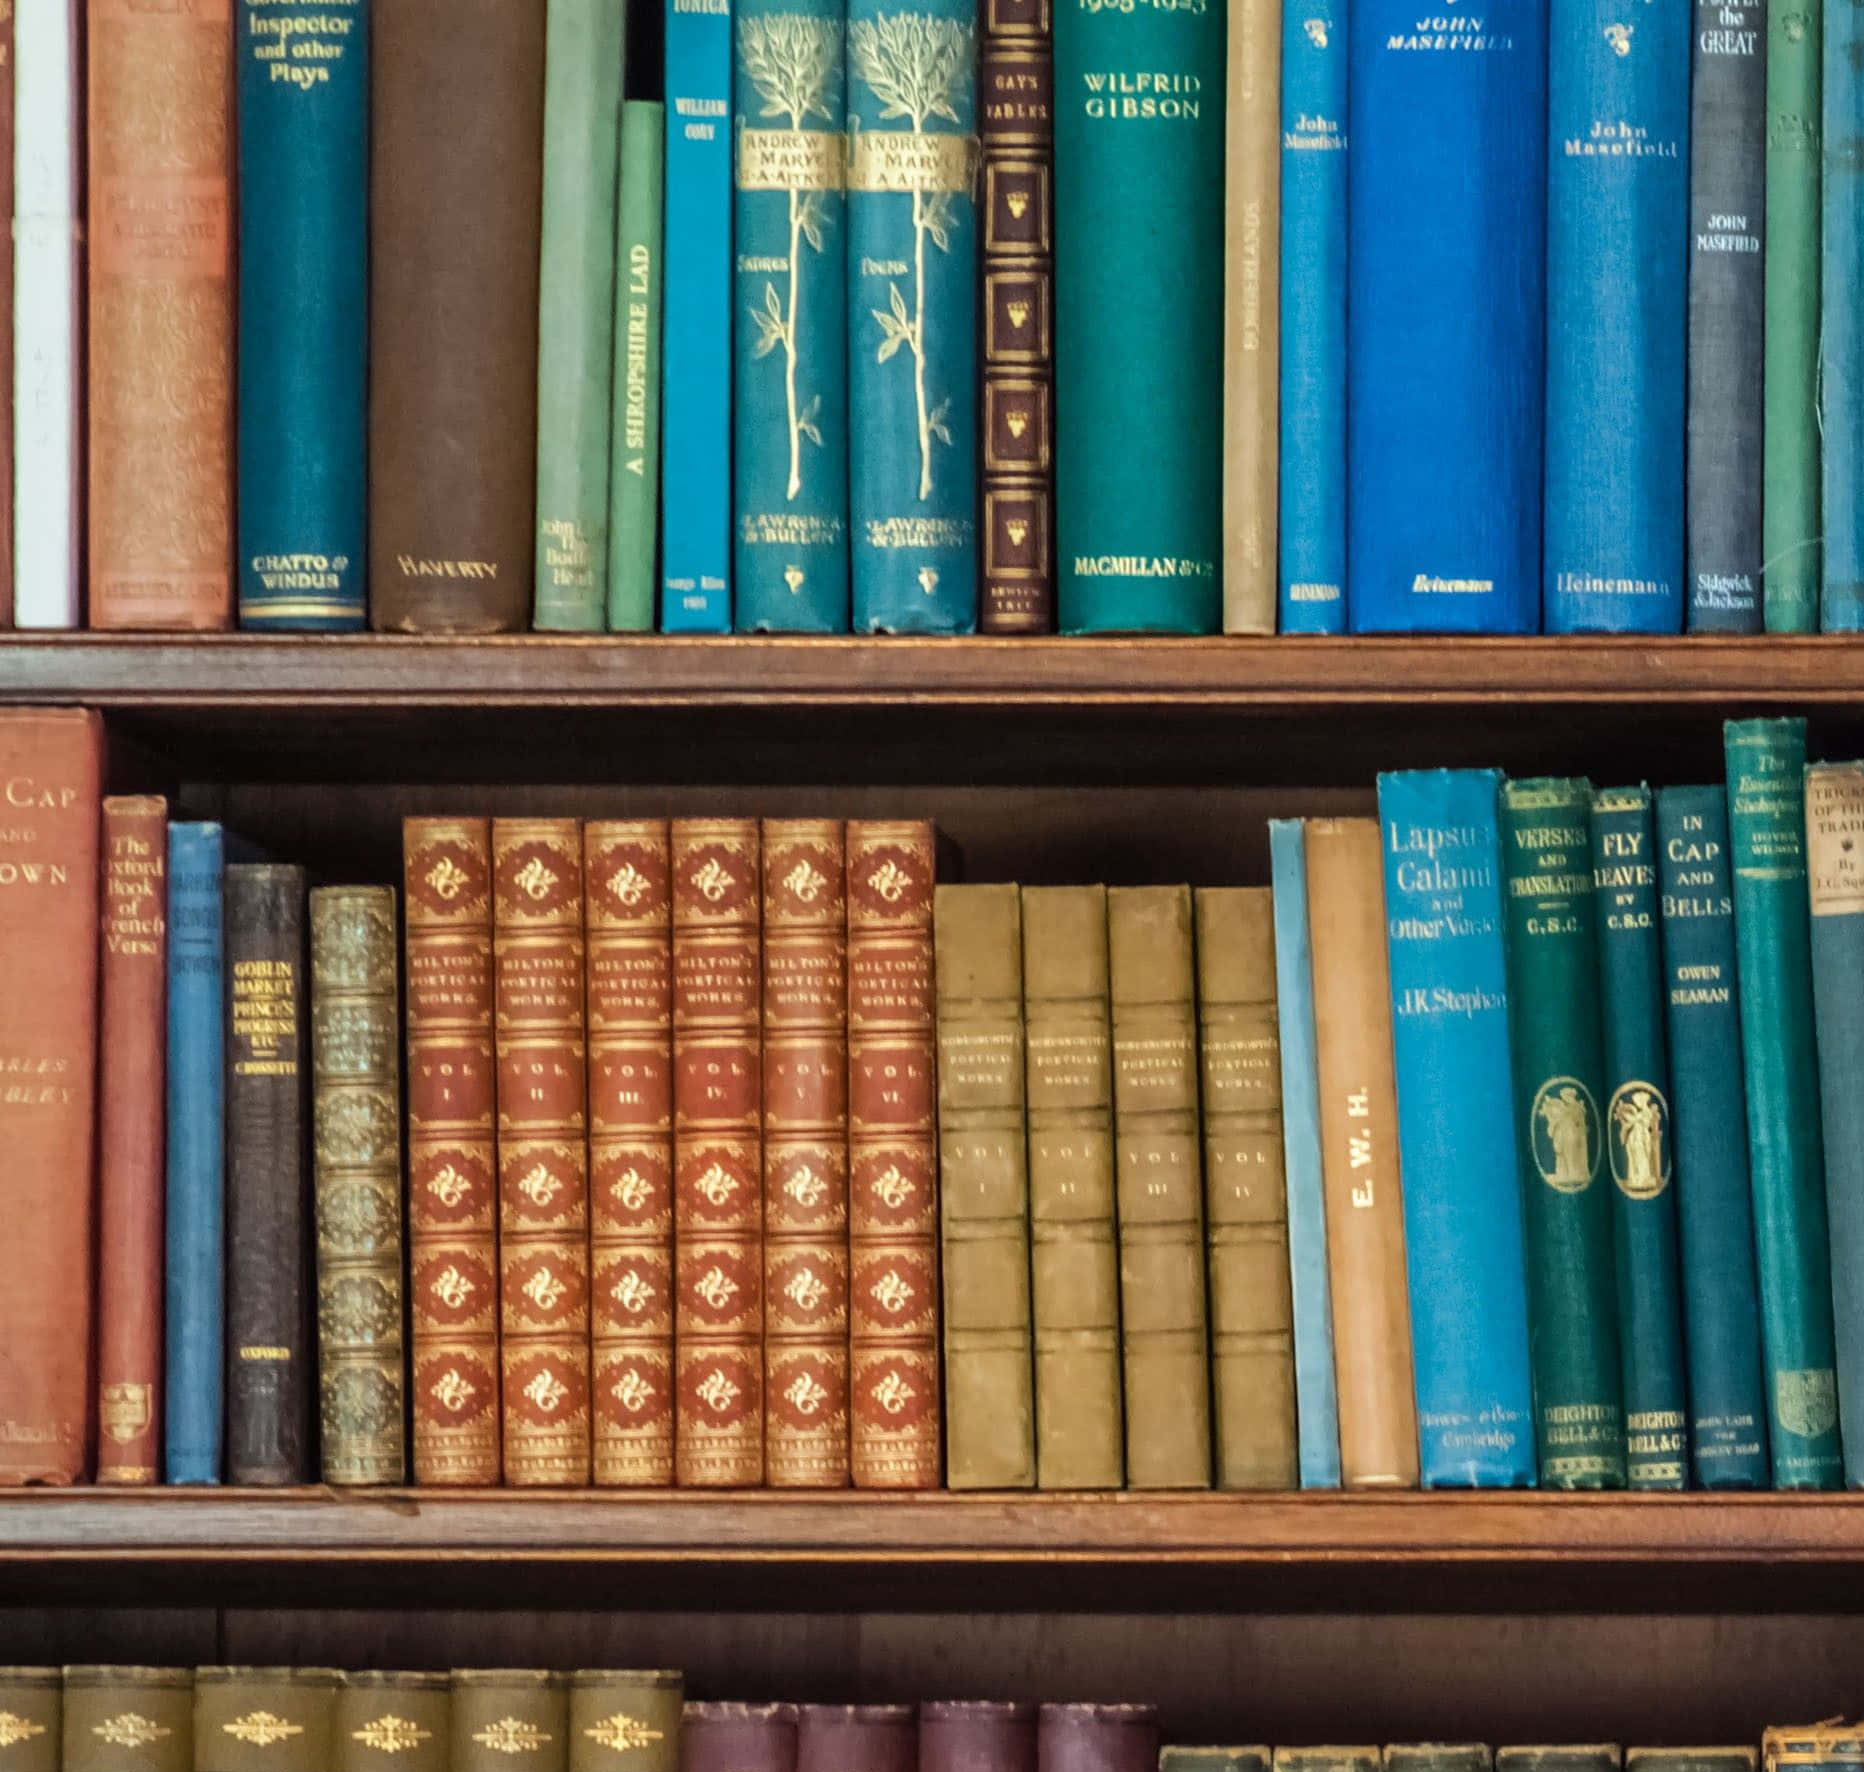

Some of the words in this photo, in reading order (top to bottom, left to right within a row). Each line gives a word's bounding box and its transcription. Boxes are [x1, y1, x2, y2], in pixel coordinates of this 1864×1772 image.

[250, 14, 352, 38] Inspector
[1700, 32, 1756, 55] GREAT
[271, 62, 329, 87] Plays
[1083, 74, 1201, 96] WILFRID
[1084, 99, 1200, 119] GIBSON
[1590, 122, 1648, 140] John
[1709, 214, 1746, 230] JOHN
[630, 243, 649, 294] LAD
[252, 557, 328, 571] CHATTO
[398, 556, 498, 579] HAVERTY
[113, 838, 150, 856] The
[1602, 832, 1640, 858] FLY
[1668, 840, 1720, 863] CAP
[109, 880, 153, 898] Book
[1661, 894, 1731, 918] BELLS
[235, 963, 290, 977] GOBLIN
[1678, 965, 1720, 981] OWEN
[1671, 985, 1728, 1005] SEAMAN
